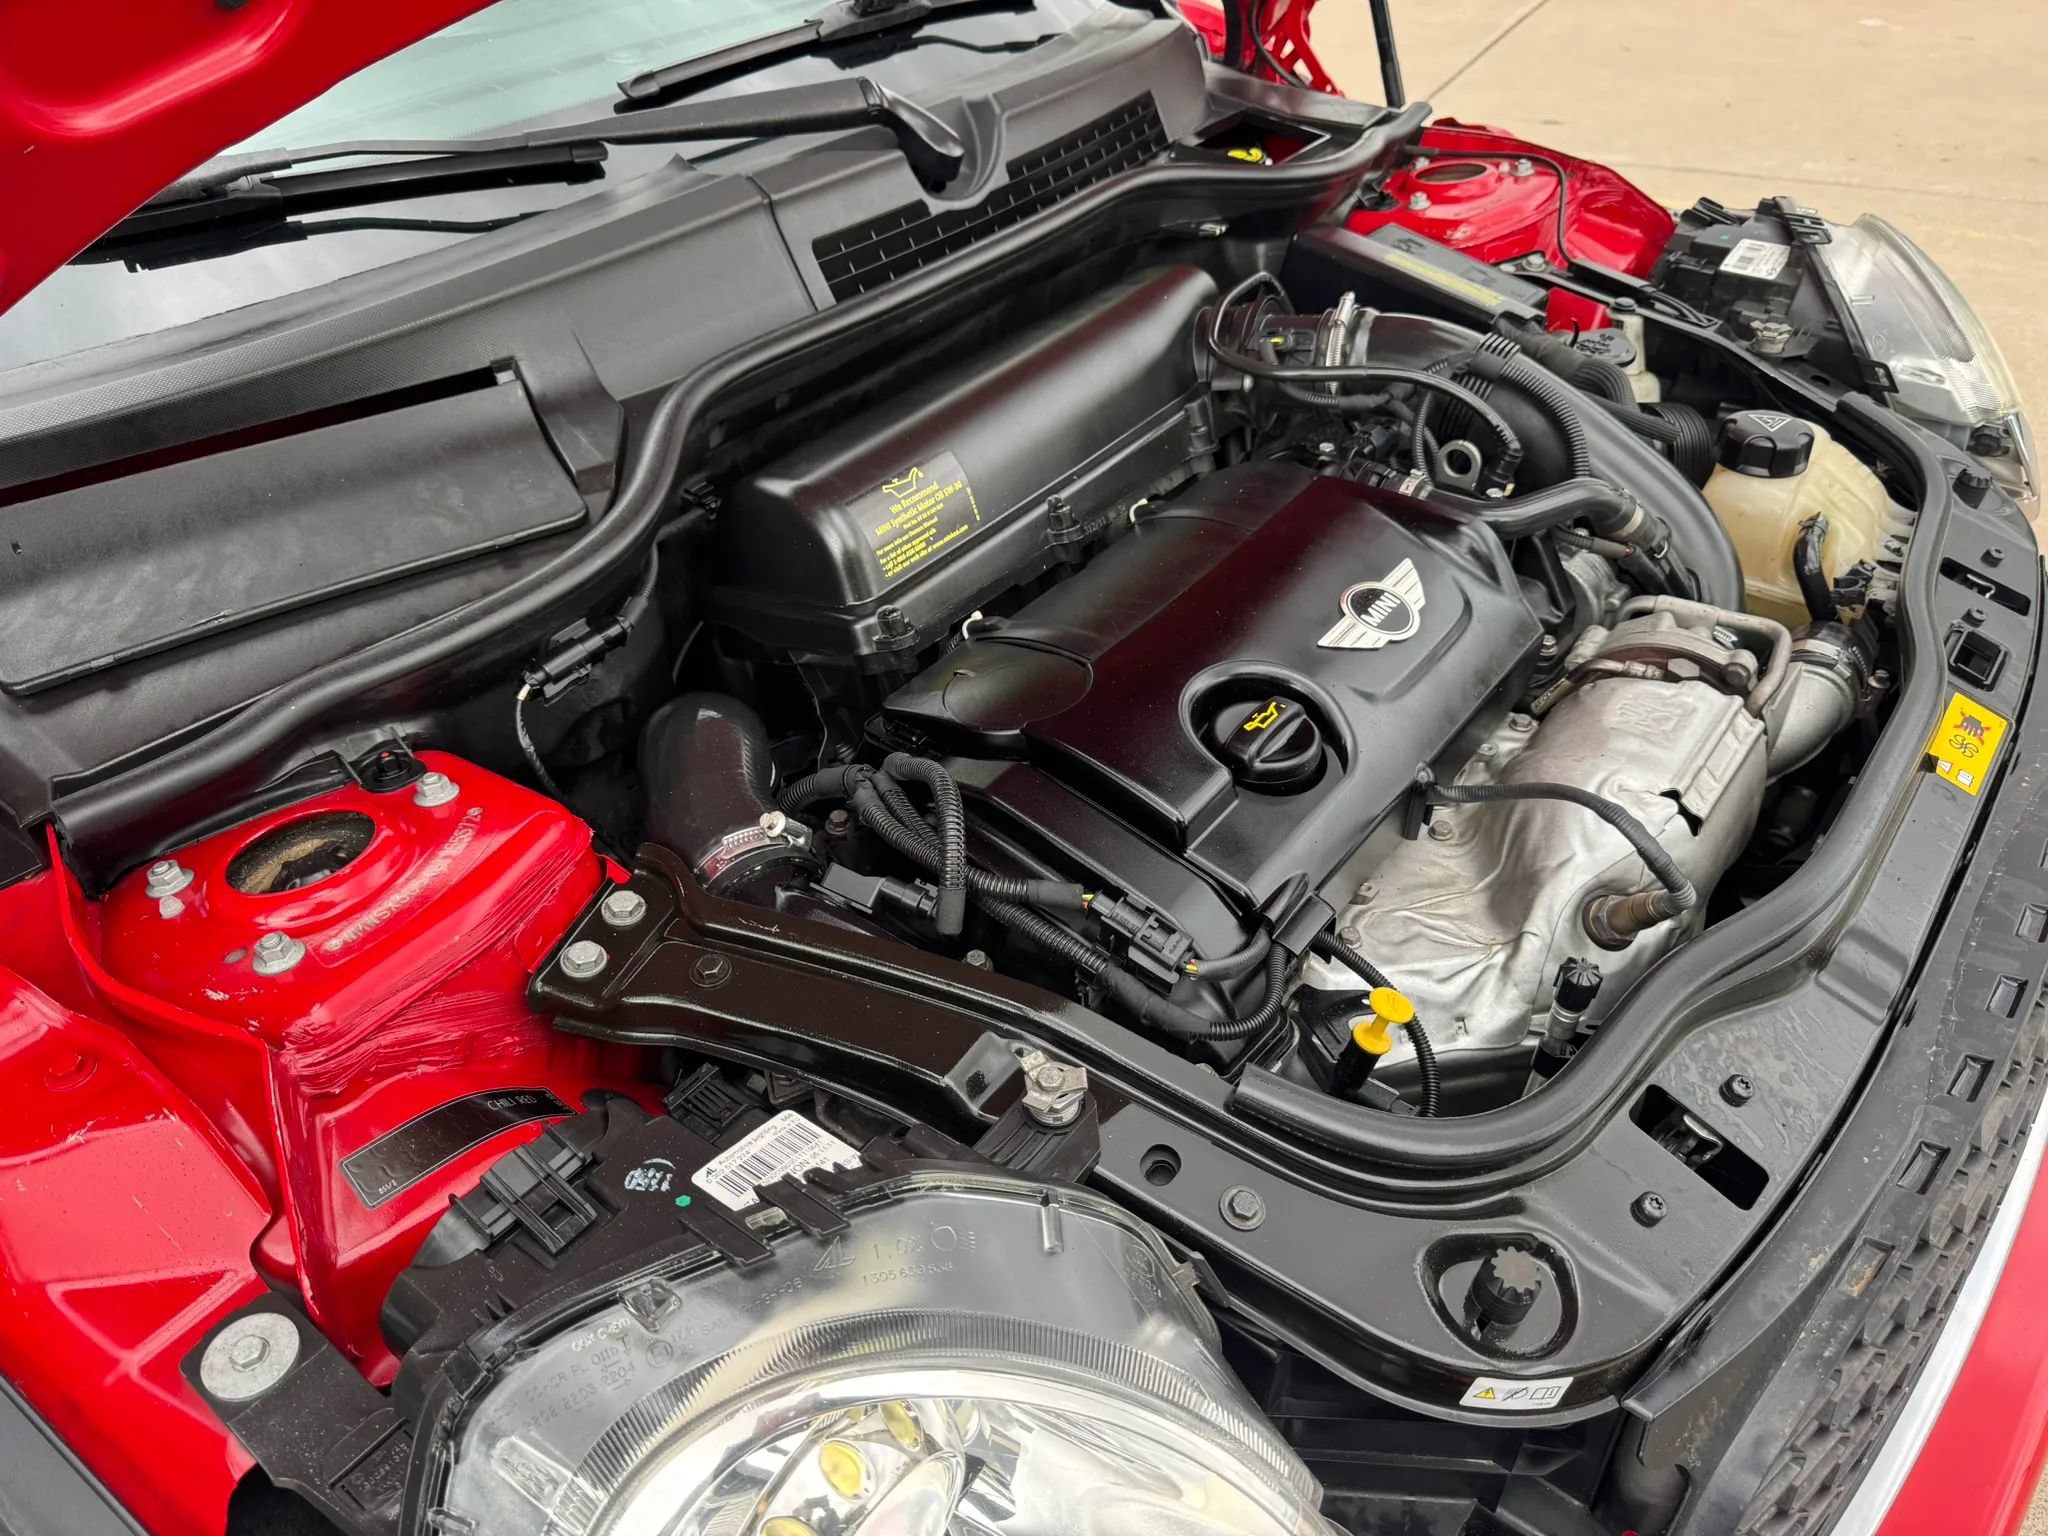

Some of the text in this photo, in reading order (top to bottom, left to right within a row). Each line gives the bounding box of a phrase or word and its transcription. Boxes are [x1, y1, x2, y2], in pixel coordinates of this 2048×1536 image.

[889, 481, 940, 514] We Recommend
[890, 507, 919, 528] Synthetic
[917, 497, 936, 512] Motor
[943, 481, 963, 497] 5W-30
[1360, 591, 1401, 627] MINI
[487, 1094, 515, 1111] CHILI
